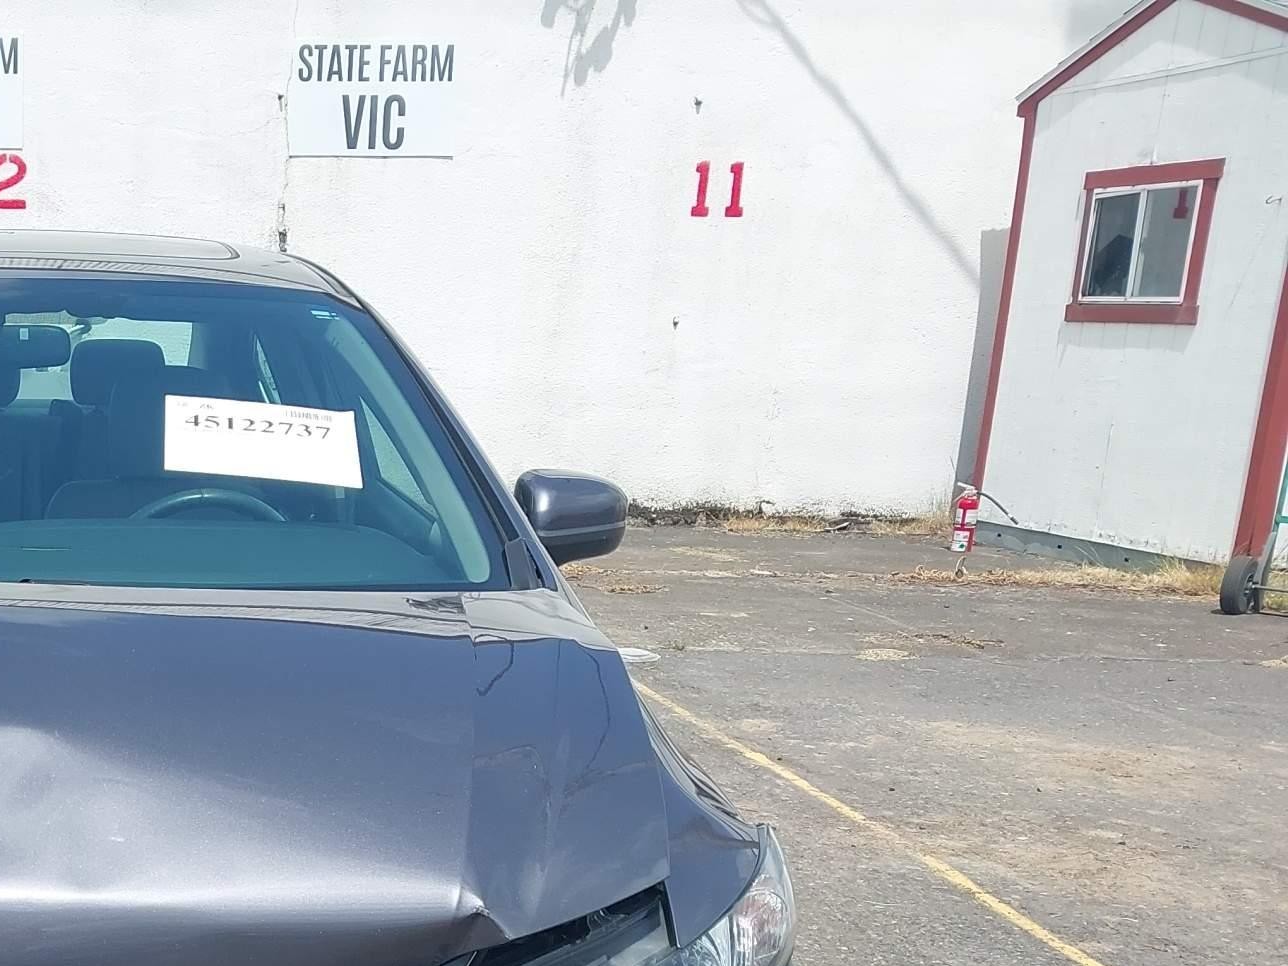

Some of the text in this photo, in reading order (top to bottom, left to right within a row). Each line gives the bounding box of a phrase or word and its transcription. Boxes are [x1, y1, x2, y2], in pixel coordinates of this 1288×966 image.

[298, 44, 455, 82] STATE FARM
[342, 94, 407, 151] VIC
[690, 161, 745, 218] 11
[184, 413, 331, 440] 45122737
